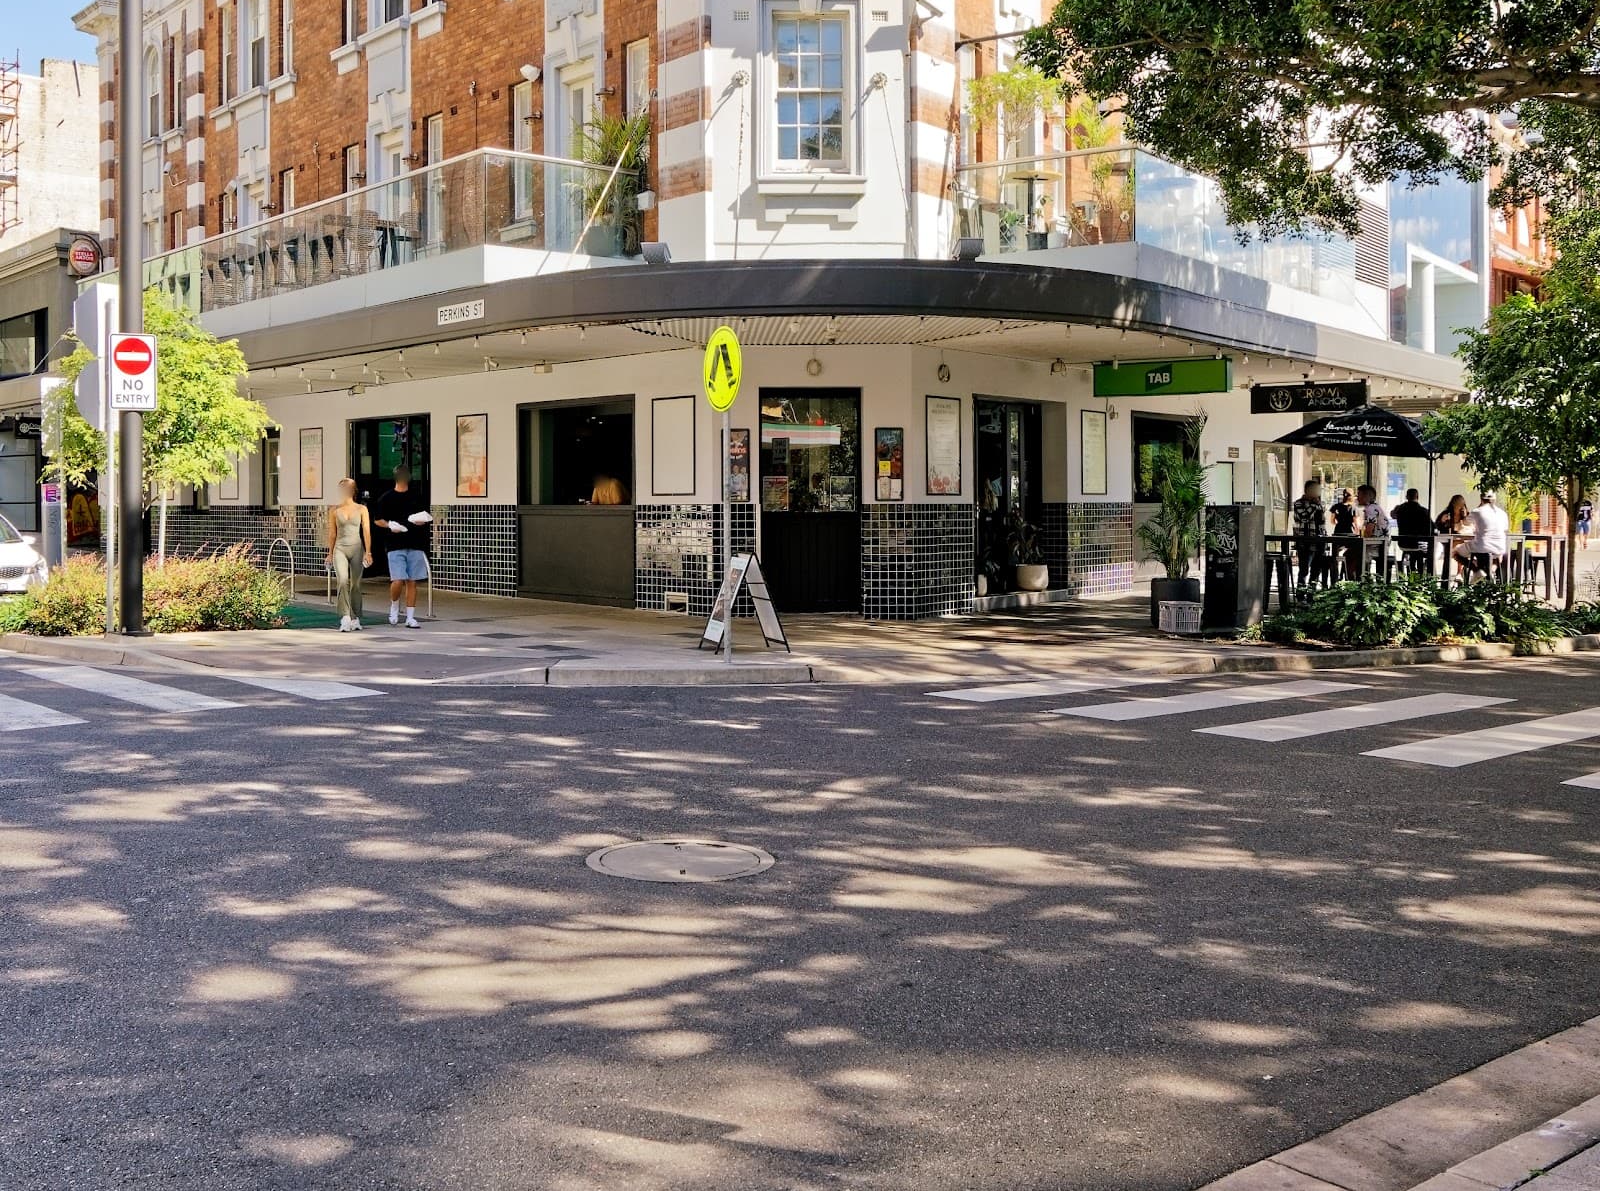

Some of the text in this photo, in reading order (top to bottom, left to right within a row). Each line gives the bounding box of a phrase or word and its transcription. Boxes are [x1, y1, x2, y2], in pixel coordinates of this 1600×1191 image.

[439, 302, 483, 322] PERKINS ST
[1147, 372, 1171, 383] TAB
[123, 379, 143, 391] NO
[115, 394, 150, 403] ENTRY
[1297, 387, 1341, 399] ROW
[1308, 397, 1348, 406] ANCHOR
[1323, 420, 1394, 433] James Squire
